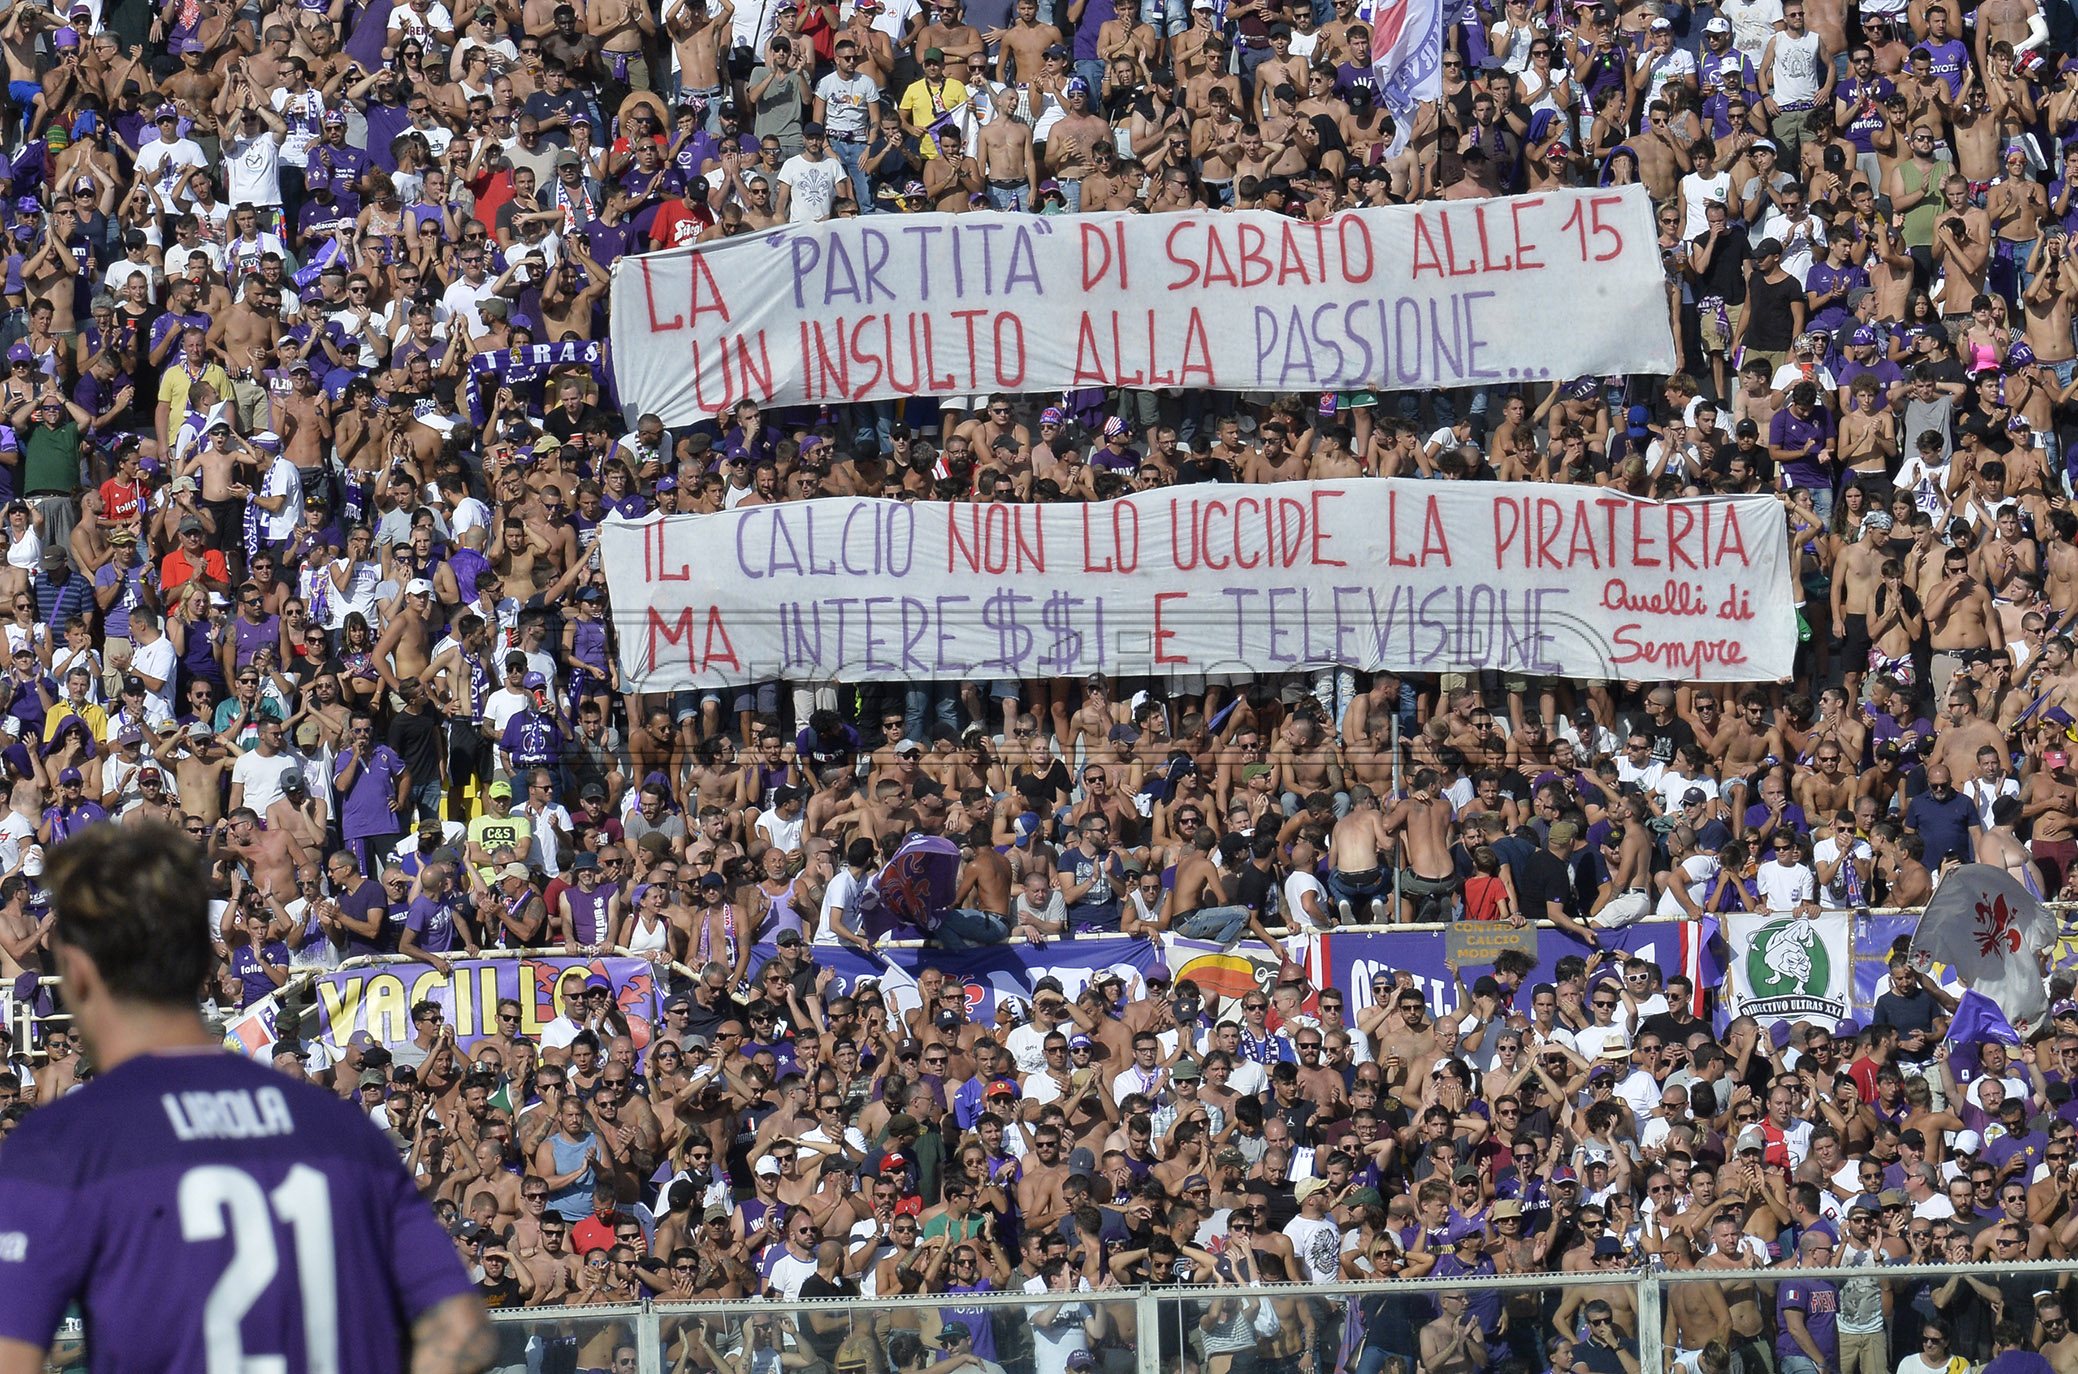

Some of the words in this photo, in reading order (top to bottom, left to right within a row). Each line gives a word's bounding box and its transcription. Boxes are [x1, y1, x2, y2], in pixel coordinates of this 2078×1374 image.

[640, 249, 730, 333] LA
[1080, 220, 1128, 292] DI
[1165, 213, 1376, 292] SABATO
[1412, 198, 1546, 280] ALLE
[1560, 196, 1624, 263] 15
[693, 329, 774, 413] UN
[800, 309, 1027, 401] INSULTO
[1073, 306, 1216, 387] ALLA
[1254, 291, 1551, 390] PASSIONE...
[644, 517, 691, 583] IL
[736, 502, 916, 579] CALCIO
[947, 500, 1046, 575] NON
[1083, 499, 1140, 573] LO
[1170, 489, 1348, 570] UCCIDE
[1388, 489, 1453, 568] LA
[1493, 496, 1751, 571] PIRATERIA
[1600, 577, 1708, 622] Quelli
[1715, 579, 1756, 622] di
[647, 604, 742, 674] MA
[779, 587, 1106, 674] INTERE$$I
[1154, 591, 1189, 665] E
[1221, 582, 1571, 675] TELEVISIONE
[1608, 623, 1749, 680] Sempre
[486, 828, 511, 839] C&S
[1466, 935, 1520, 946] CALCIO
[1741, 1000, 1789, 1017] DIRECTIVO
[1790, 999, 1824, 1011] ULTRAS
[1824, 1004, 1842, 1017] XXI
[161, 1085, 295, 1142] LIROLA
[177, 1162, 340, 1374] 21
